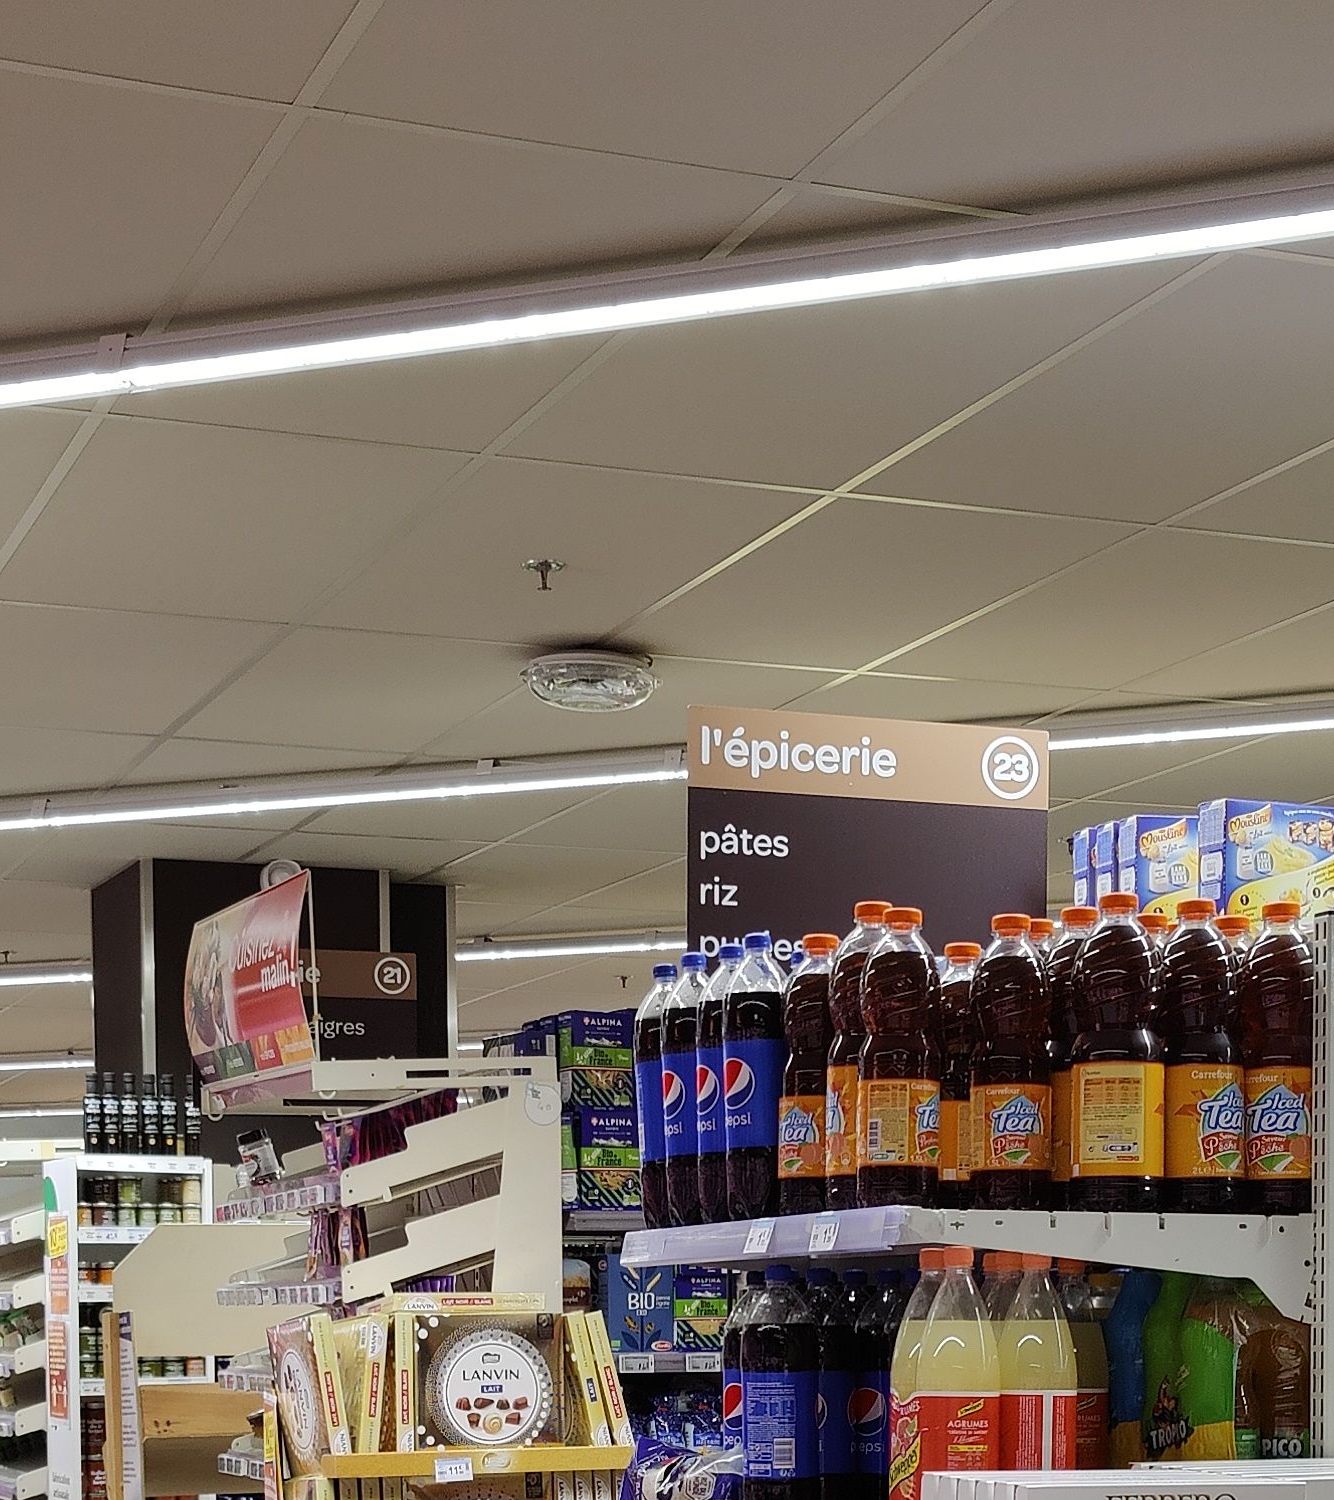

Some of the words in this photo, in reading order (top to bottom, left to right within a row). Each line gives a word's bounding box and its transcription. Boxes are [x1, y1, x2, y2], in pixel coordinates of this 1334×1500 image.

[701, 726, 898, 779] l'épicerie
[993, 753, 1030, 783] 23
[700, 825, 789, 861] pâtes
[700, 877, 739, 907] riz
[230, 935, 274, 974] Cuisinez
[384, 967, 401, 984] 21
[590, 1017, 622, 1027] ALPINA
[1191, 1069, 1233, 1081] Carrefour
[1270, 1092, 1305, 1111] Iced
[598, 1118, 632, 1127] ALPINA
[990, 1108, 1036, 1133] Tea
[1246, 1100, 1299, 1134] Tea
[628, 1292, 655, 1310] BIO
[462, 1369, 520, 1382] LANVIN
[483, 1385, 501, 1393] LAIT
[947, 1419, 989, 1429] AGRUMES
